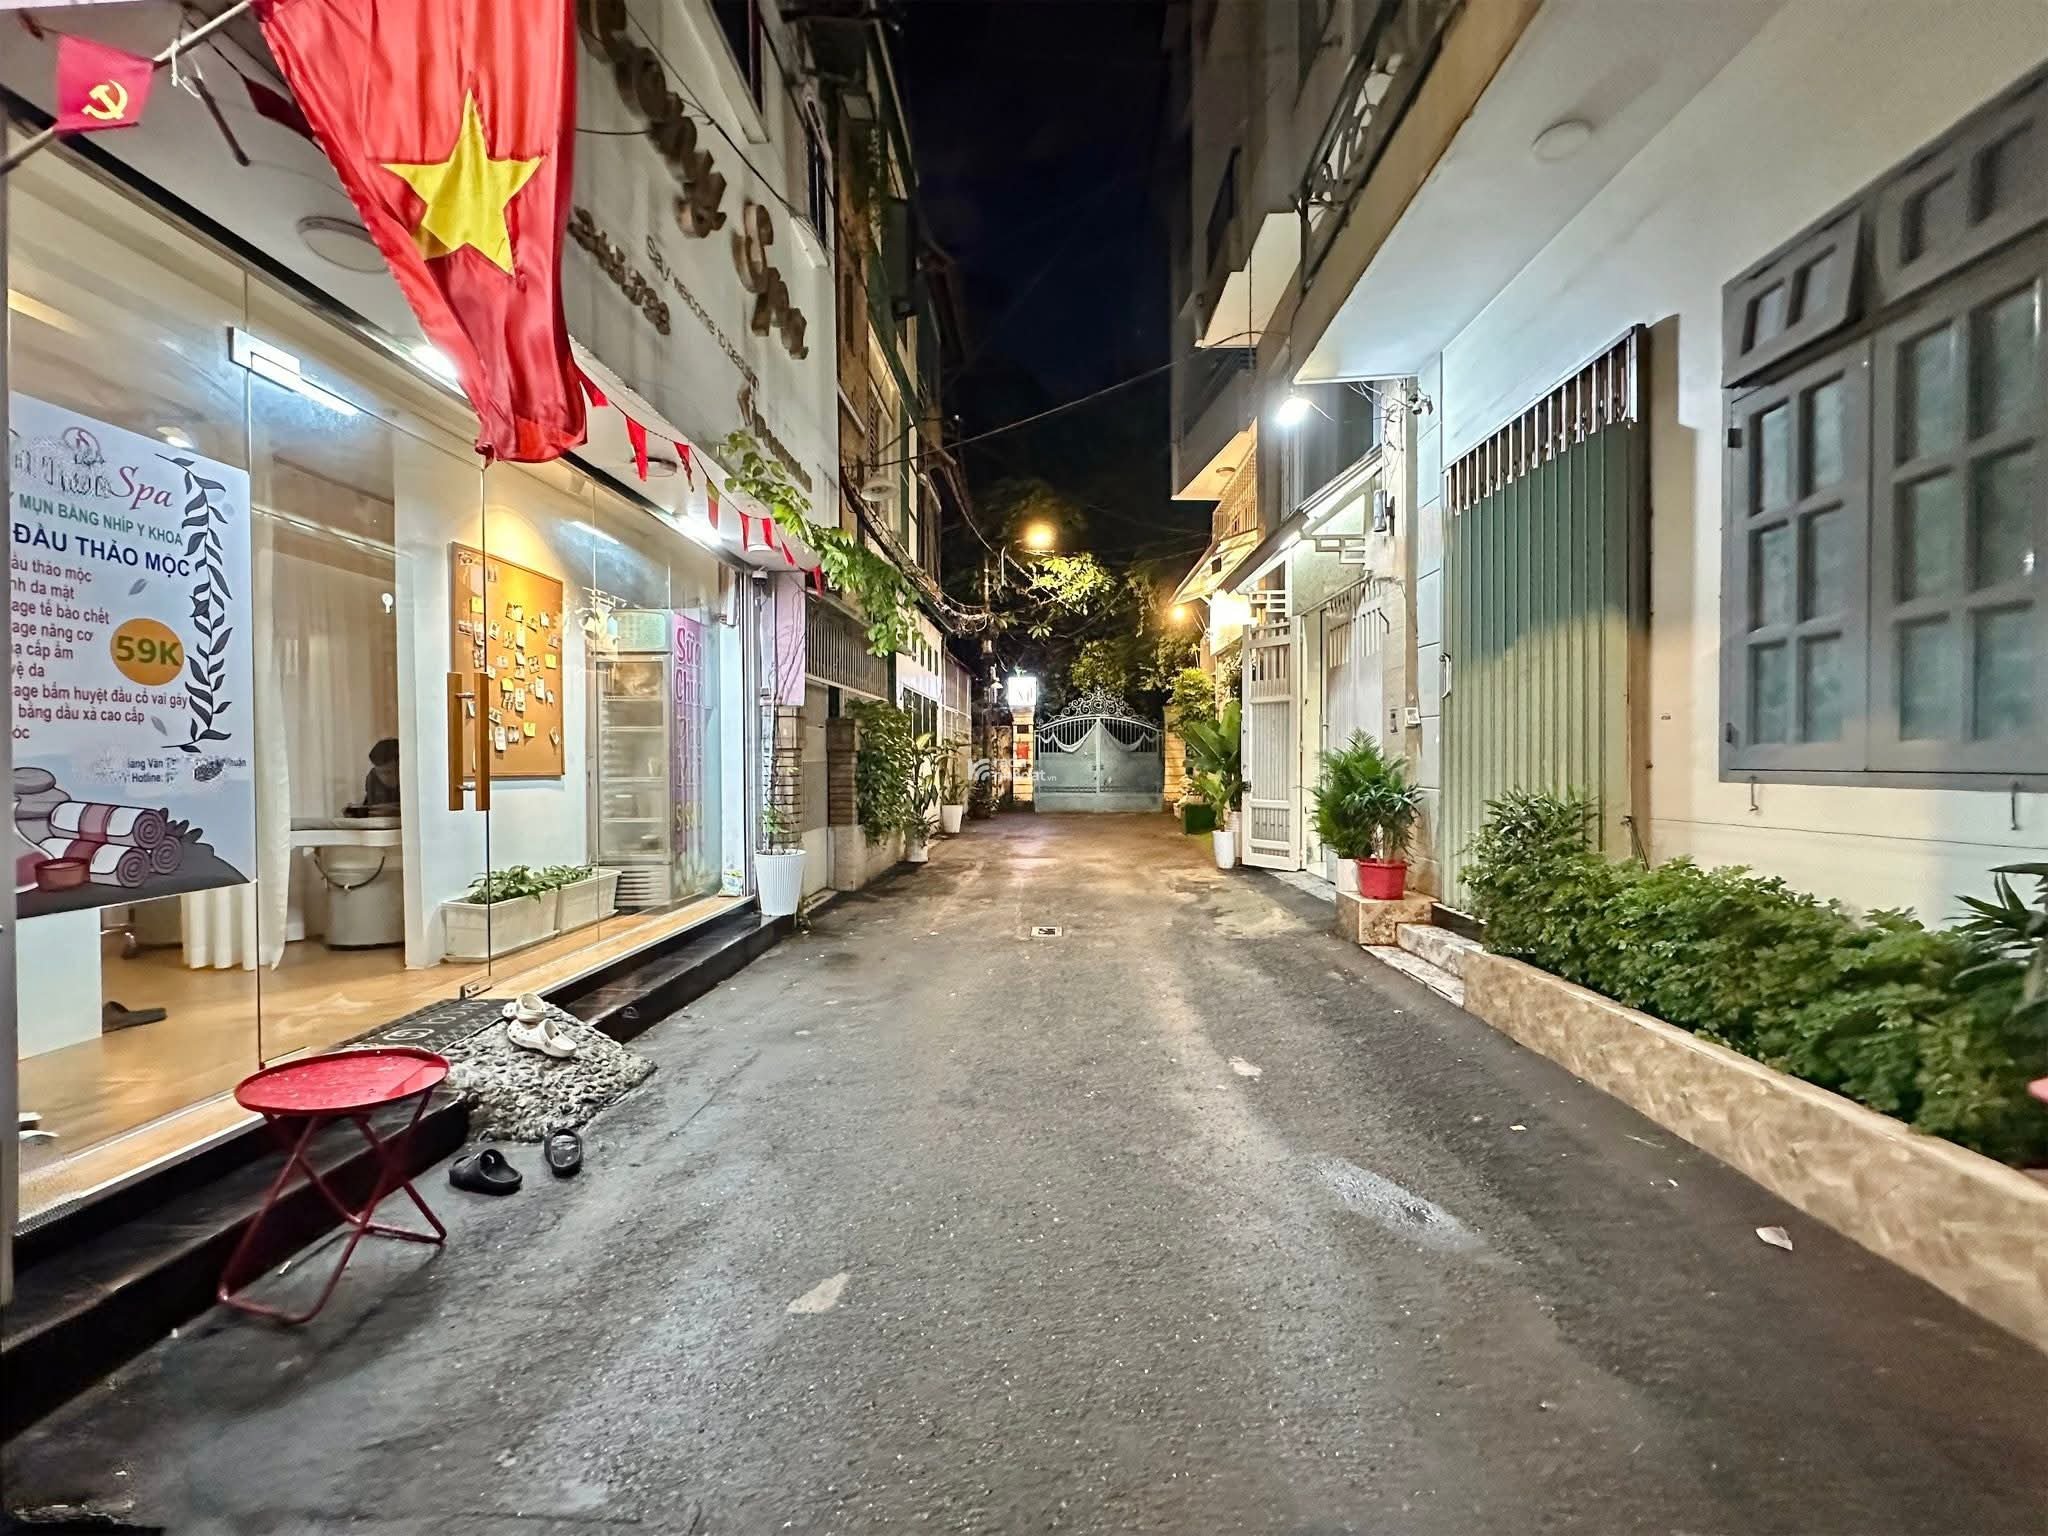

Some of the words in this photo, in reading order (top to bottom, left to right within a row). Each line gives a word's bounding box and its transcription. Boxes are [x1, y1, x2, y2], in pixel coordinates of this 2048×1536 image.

[110, 466, 174, 510] Spa
[137, 523, 145, 537] Y
[149, 526, 183, 546] KHOA
[75, 536, 138, 566] THẢO
[145, 551, 190, 578] MỘC
[30, 580, 47, 595] da
[116, 635, 181, 666] 59K
[28, 663, 45, 678] da
[74, 686, 108, 705] huyệt
[151, 691, 167, 706] vai
[100, 711, 122, 722] cao
